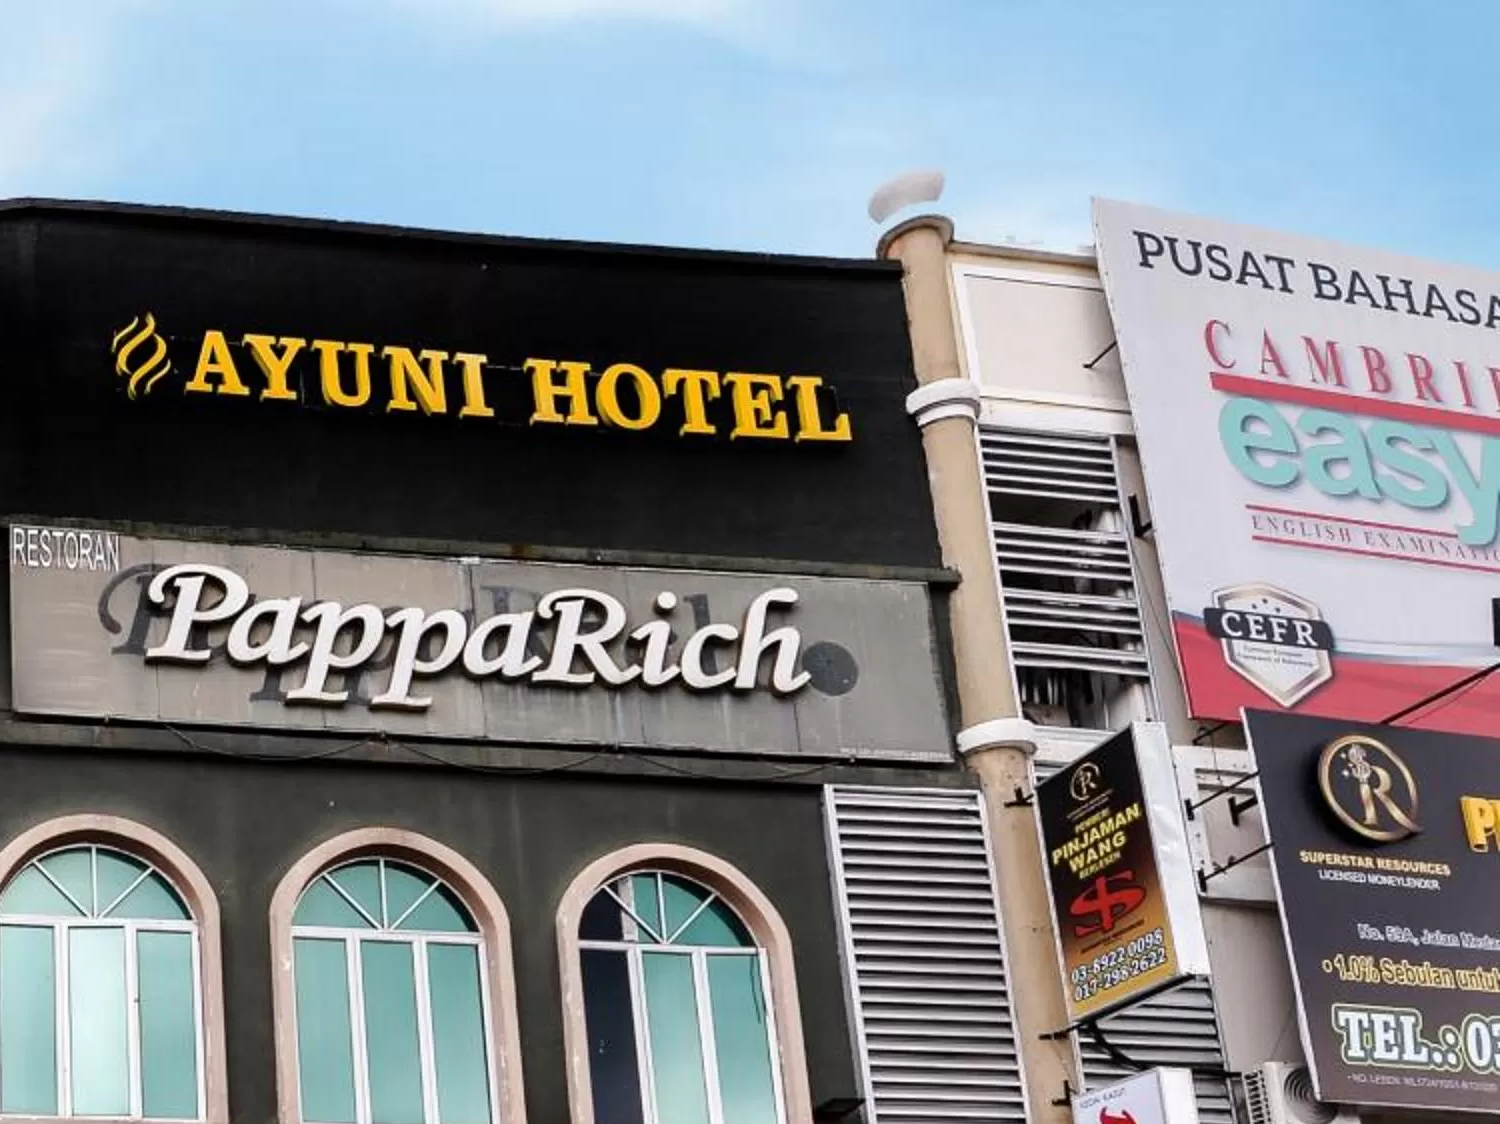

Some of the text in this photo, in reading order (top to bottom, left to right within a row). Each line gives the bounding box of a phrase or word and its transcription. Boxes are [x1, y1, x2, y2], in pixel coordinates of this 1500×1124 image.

[1132, 230, 1295, 294] PUSAT
[185, 330, 852, 444] AYUNI HOTEL
[1218, 397, 1500, 547] easy
[12, 528, 119, 573] RESTORAN
[1252, 515, 1352, 543] ENGLISH
[145, 563, 811, 711] PappaRich
[1221, 612, 1319, 648] CEFR
[1052, 802, 1142, 865] PINJAMAN
[1068, 831, 1127, 873] WANG
[1300, 850, 1451, 876] SUPERSTAR RESOURCES
[1380, 958, 1456, 988] Sebulan
